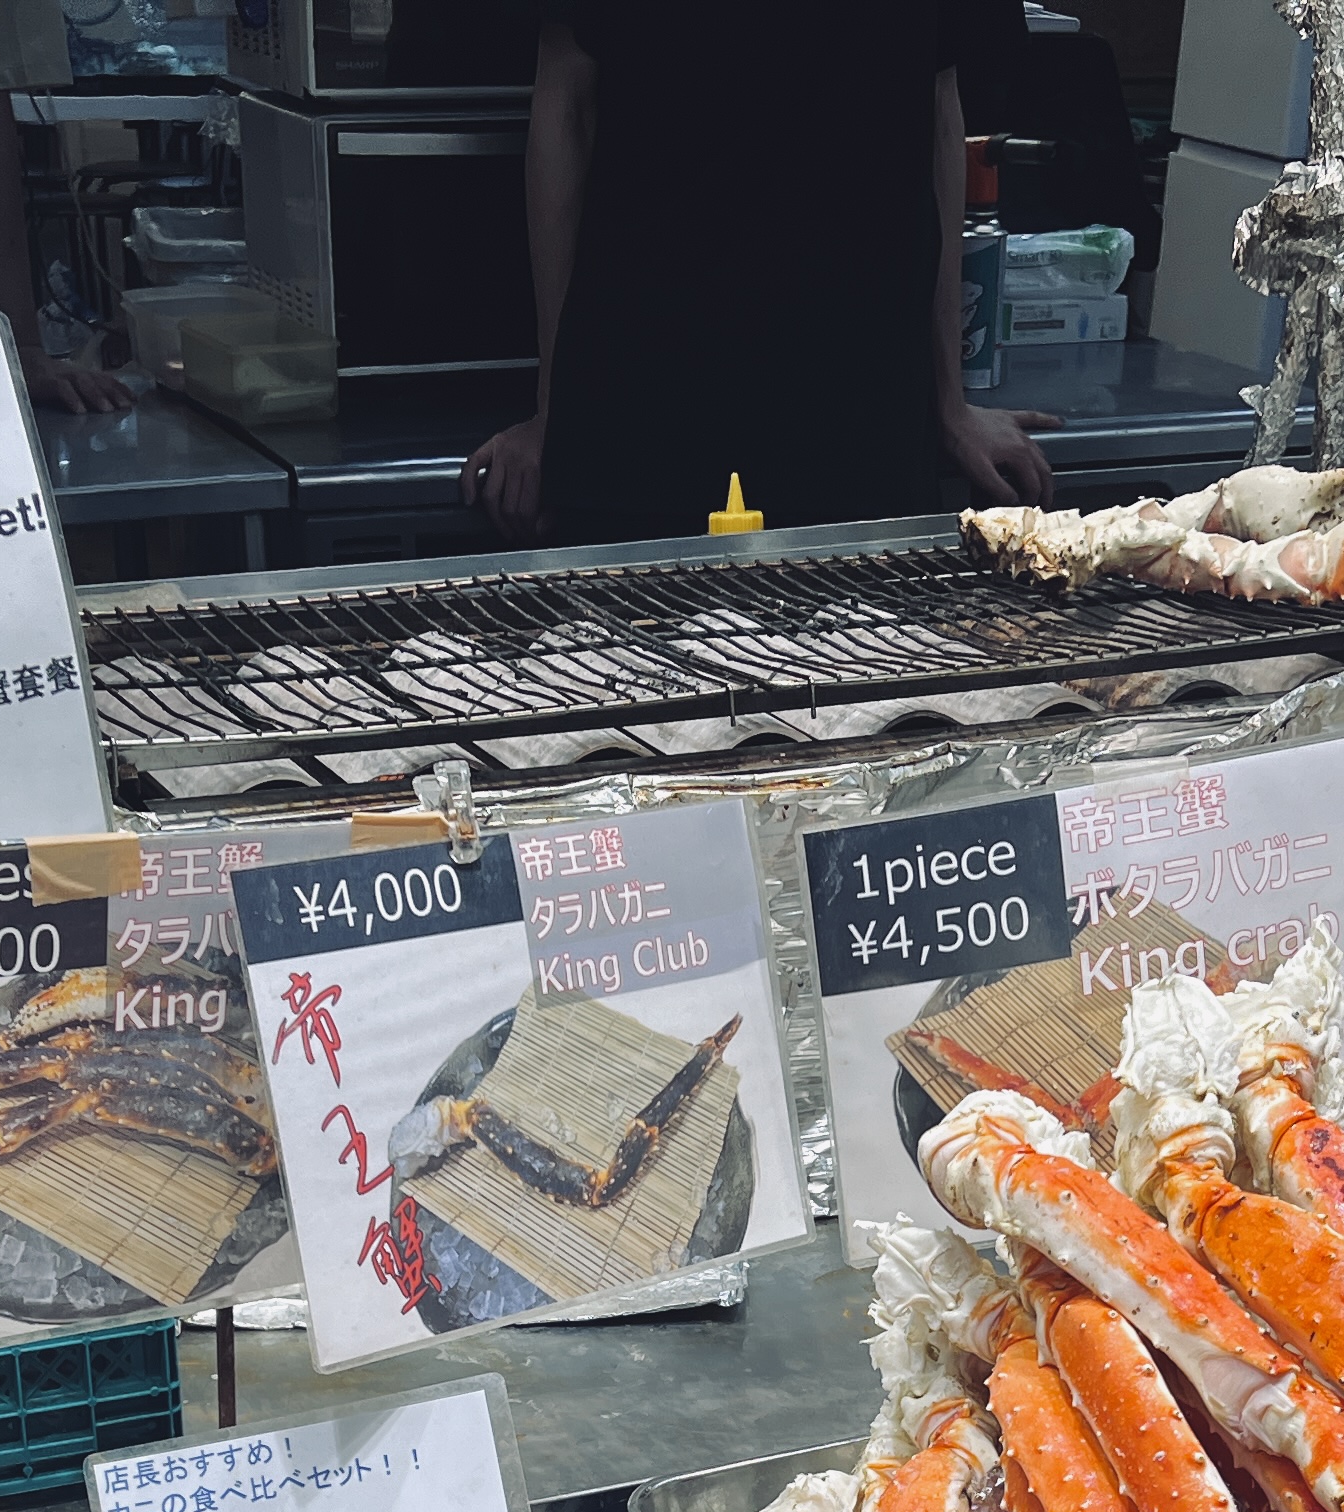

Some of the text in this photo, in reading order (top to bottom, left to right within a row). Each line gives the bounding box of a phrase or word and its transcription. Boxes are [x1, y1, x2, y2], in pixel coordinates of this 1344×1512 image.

[1063, 773, 1229, 854] 帝王蟹
[518, 825, 627, 884] 帝王蟹
[851, 838, 1017, 905] 1piece
[294, 863, 462, 936] ¥4,000
[529, 879, 672, 941] タラバガニ
[847, 895, 1030, 967] ¥4,500
[537, 930, 711, 996] King Club
[1078, 935, 1207, 996] King
[113, 985, 229, 1034] King
[104, 1437, 294, 1495] 店長おすすめ！
